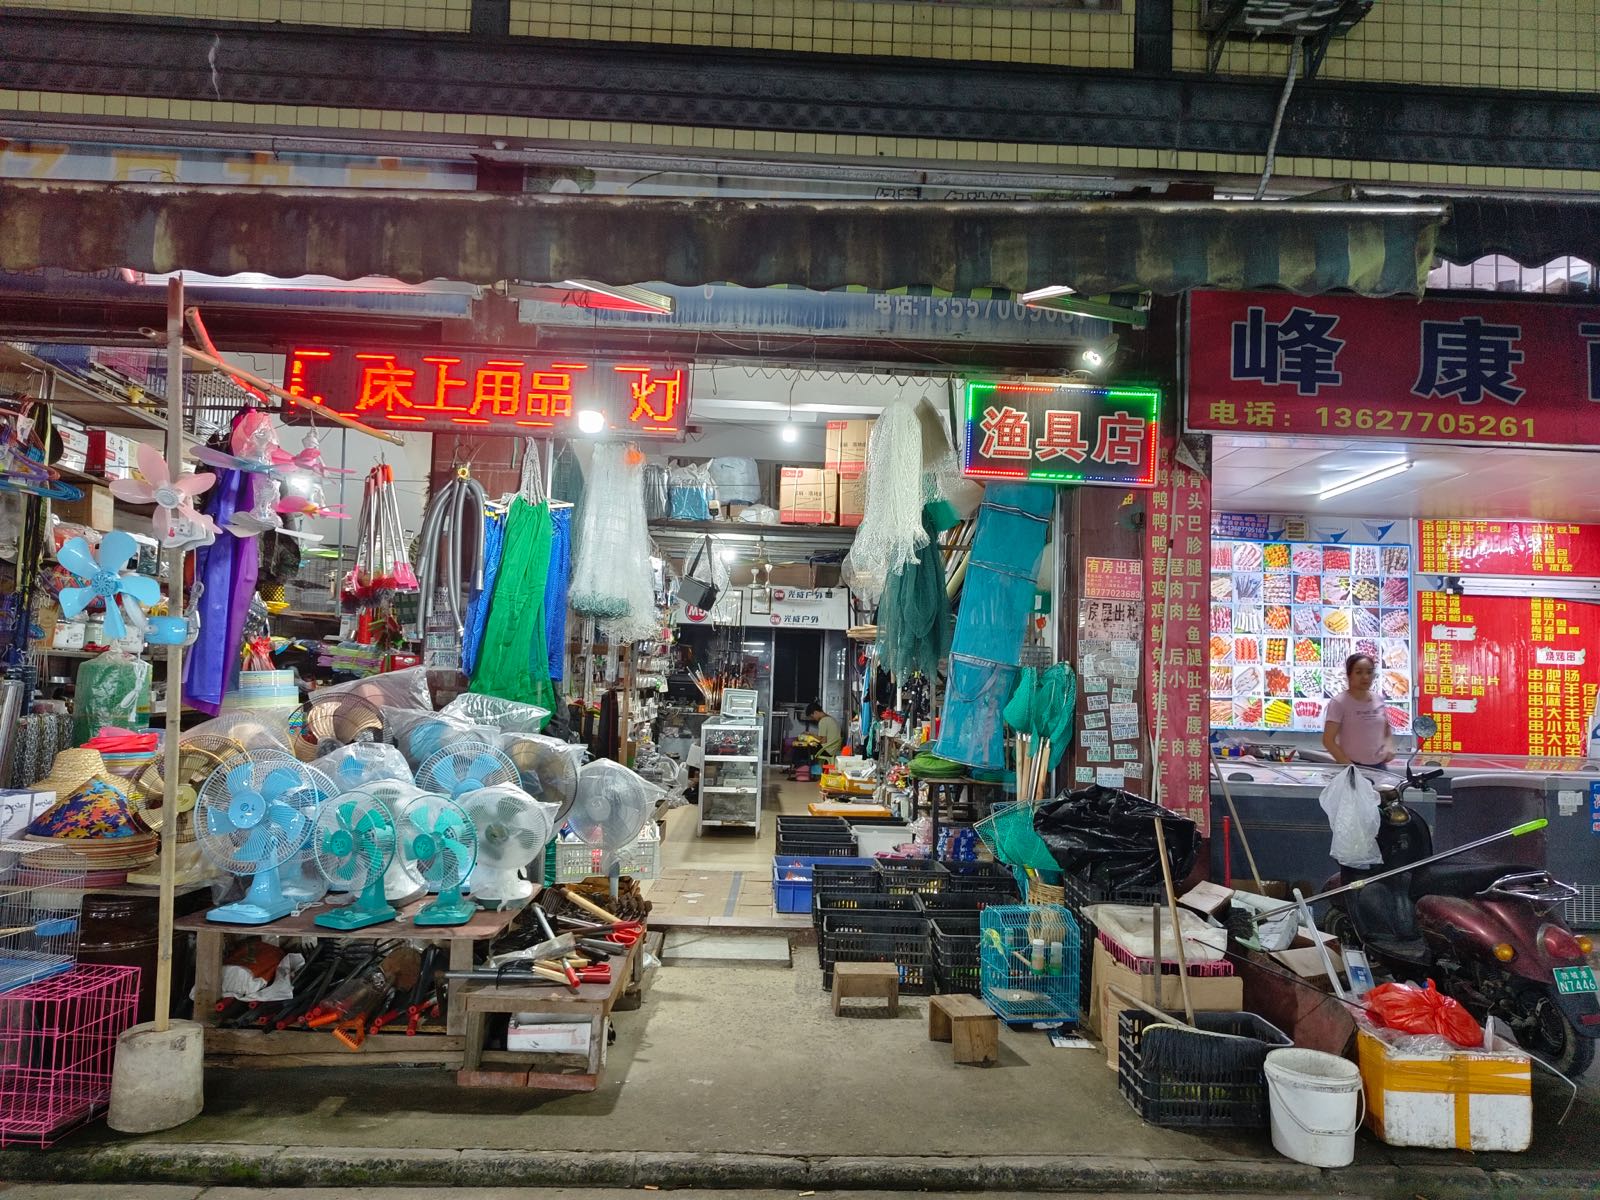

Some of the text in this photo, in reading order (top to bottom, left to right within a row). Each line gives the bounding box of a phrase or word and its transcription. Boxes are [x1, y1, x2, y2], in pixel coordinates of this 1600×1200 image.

[1231, 306, 1600, 405] 峰康
[355, 362, 572, 418] 床上用品
[1315, 406, 1536, 437] 13627705261
[978, 406, 1148, 466] 渔具店
[1152, 491, 1203, 510] 鸭头
[1152, 513, 1203, 532] 鸭下巴
[1087, 559, 1141, 575] 有房出租
[1151, 558, 1202, 577] 琵琶腿
[1151, 581, 1202, 599] 鸡肉丁
[1151, 603, 1202, 621] 鸡肉丝
[1545, 652, 1576, 662] 烧烤串
[1528, 669, 1580, 683] 串肥肠
[1560, 980, 1596, 993] N7446
